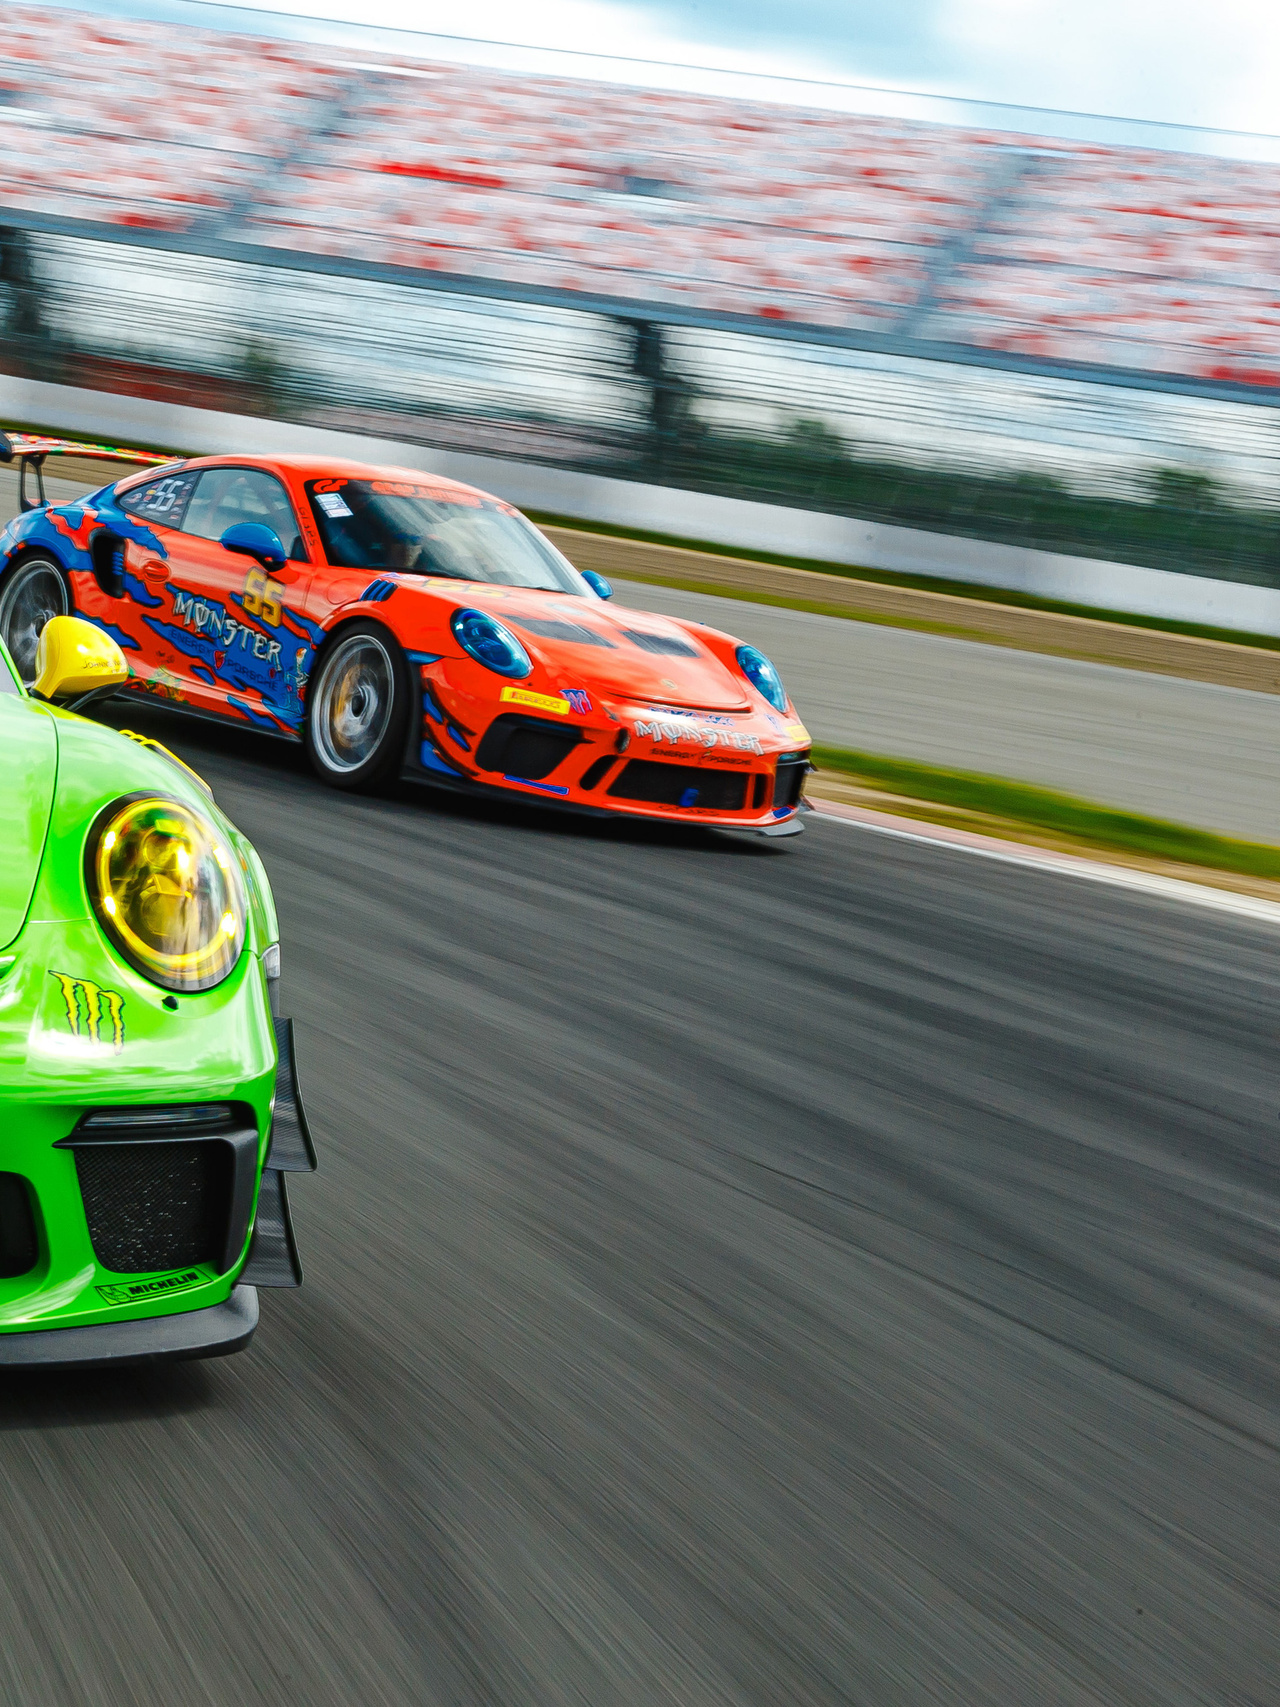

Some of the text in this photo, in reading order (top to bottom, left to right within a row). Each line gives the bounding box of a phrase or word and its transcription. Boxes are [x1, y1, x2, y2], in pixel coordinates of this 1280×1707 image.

[242, 566, 286, 628] 55
[170, 627, 280, 692] ENERGY PORSCHE
[173, 592, 283, 672] MONSTER
[633, 719, 765, 756] MONSTER
[128, 1271, 200, 1295] MICHELIN
